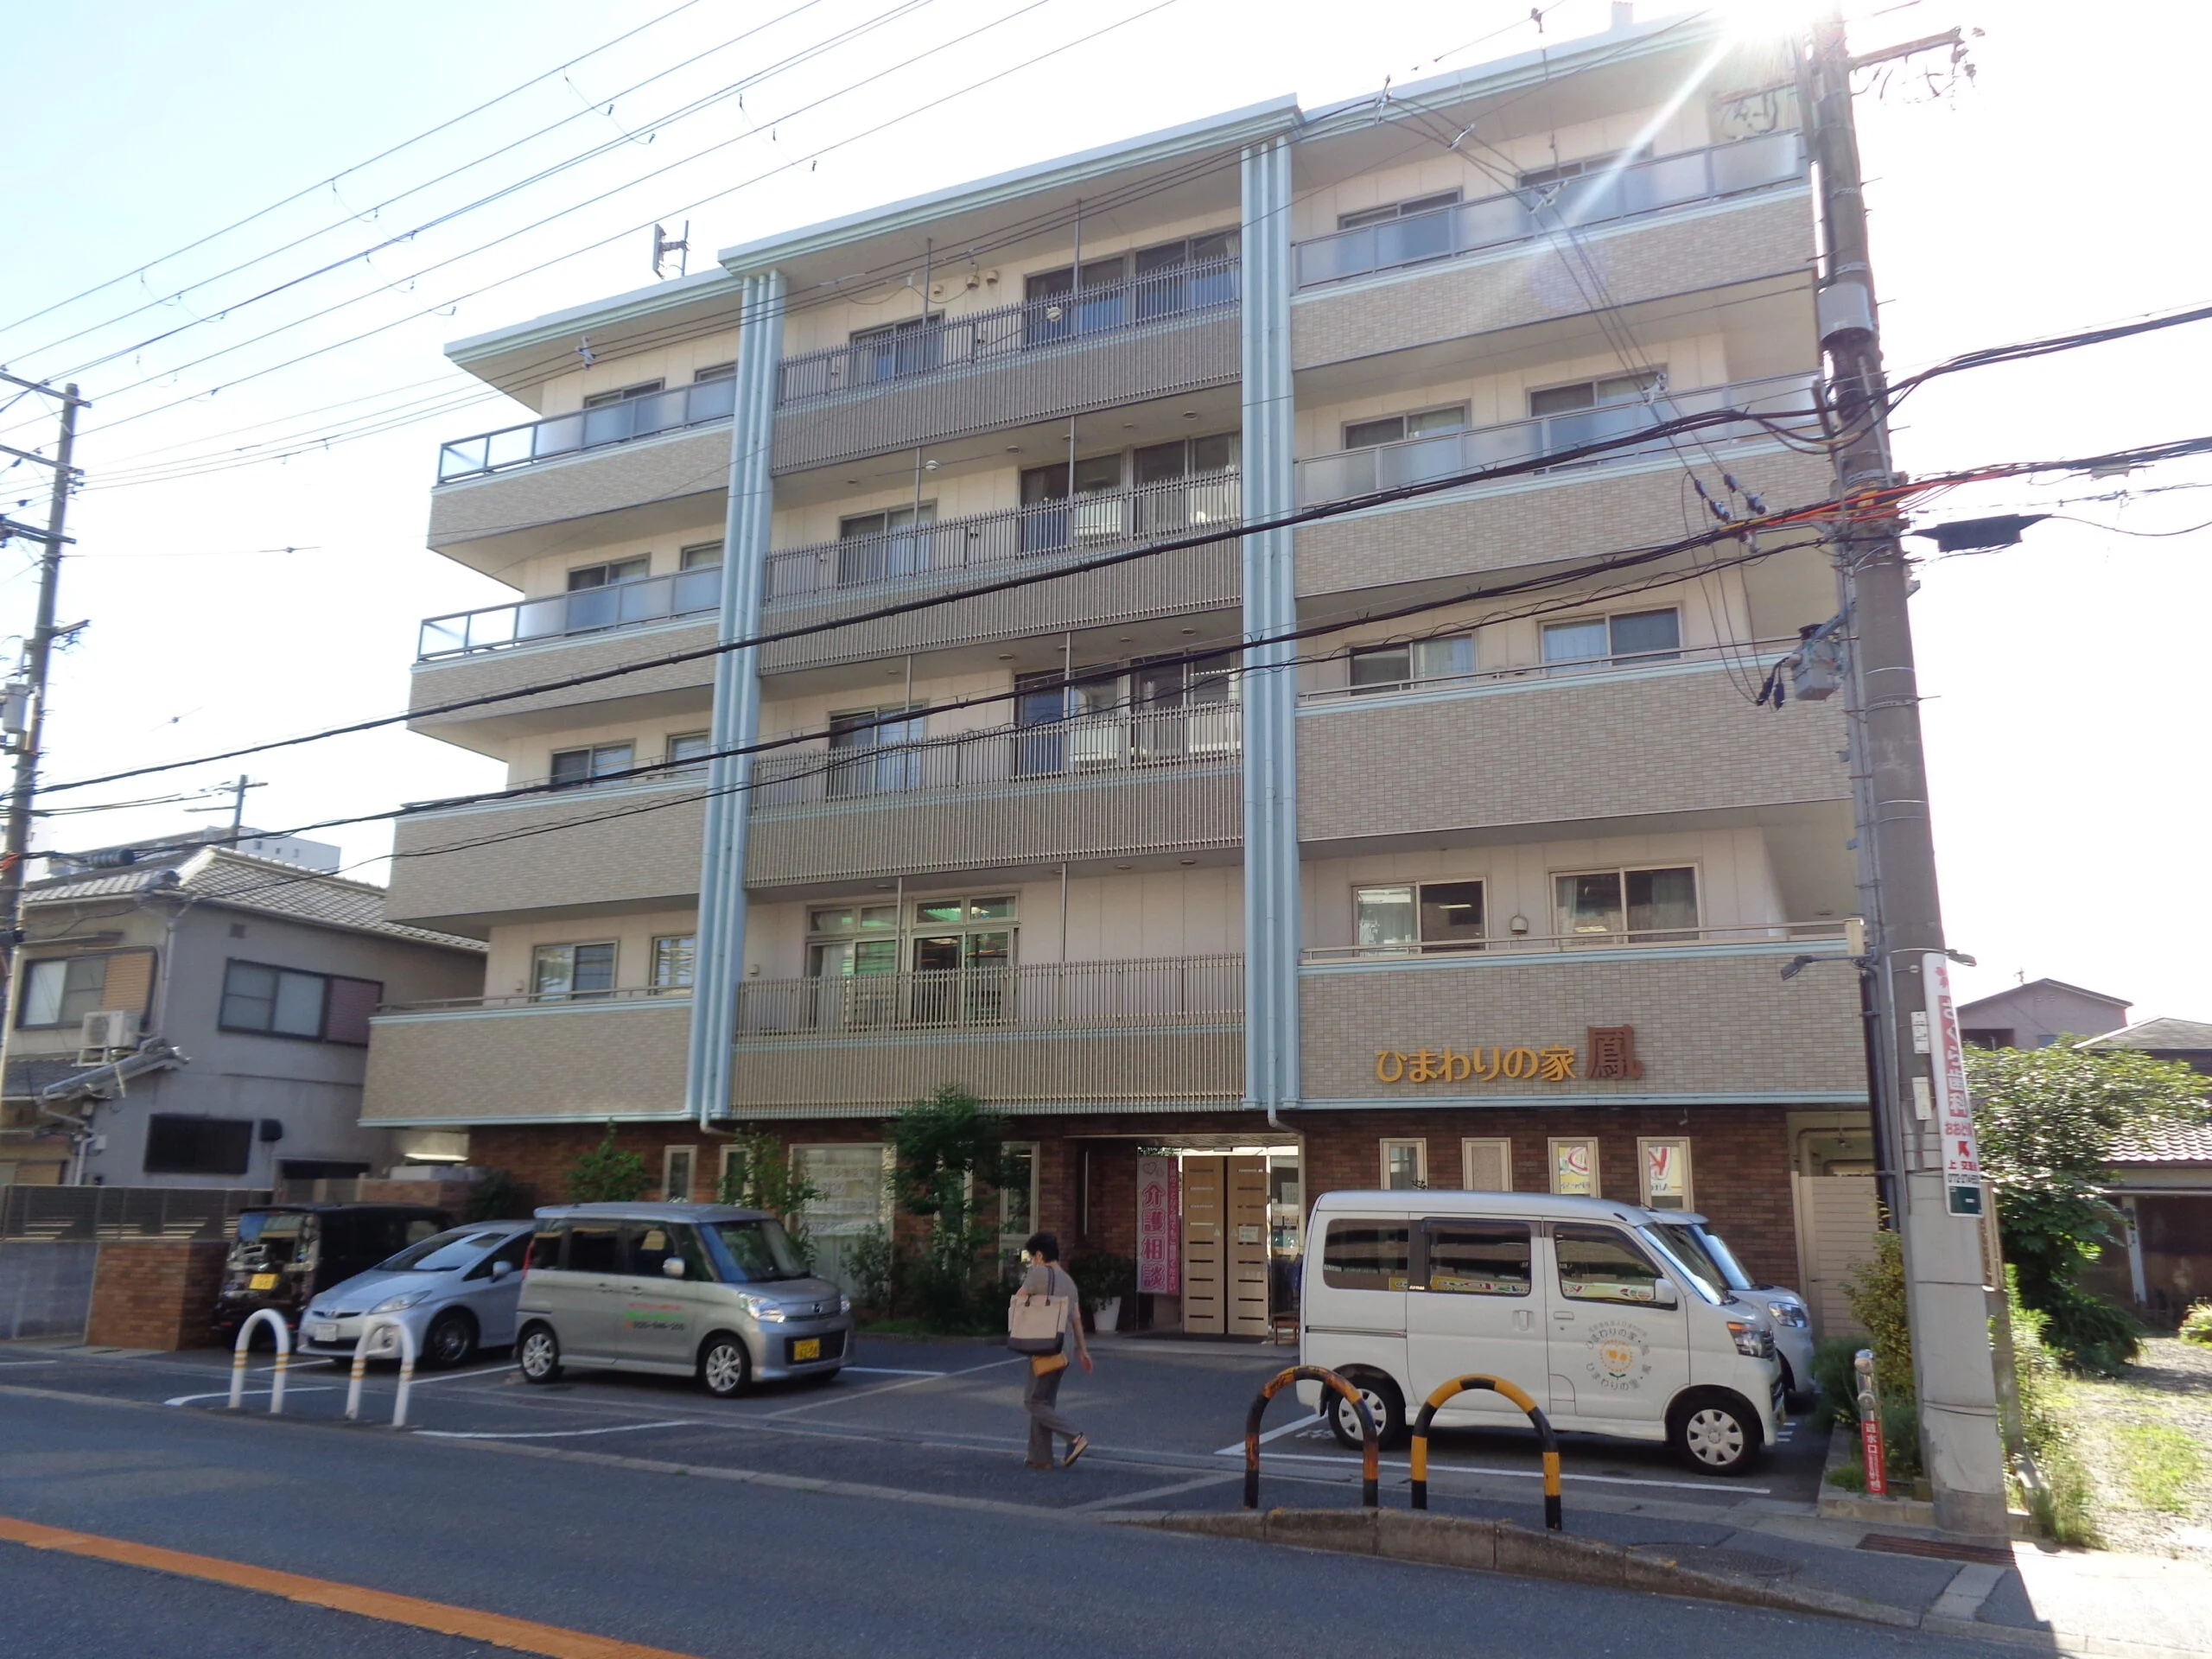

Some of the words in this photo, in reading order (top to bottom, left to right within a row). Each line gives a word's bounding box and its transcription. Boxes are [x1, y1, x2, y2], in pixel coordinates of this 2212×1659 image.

[1375, 1044, 1577, 1084] ひまわりの家
[1585, 1024, 1643, 1081] 鳳
[1141, 1181, 1165, 1290] 介護相談
